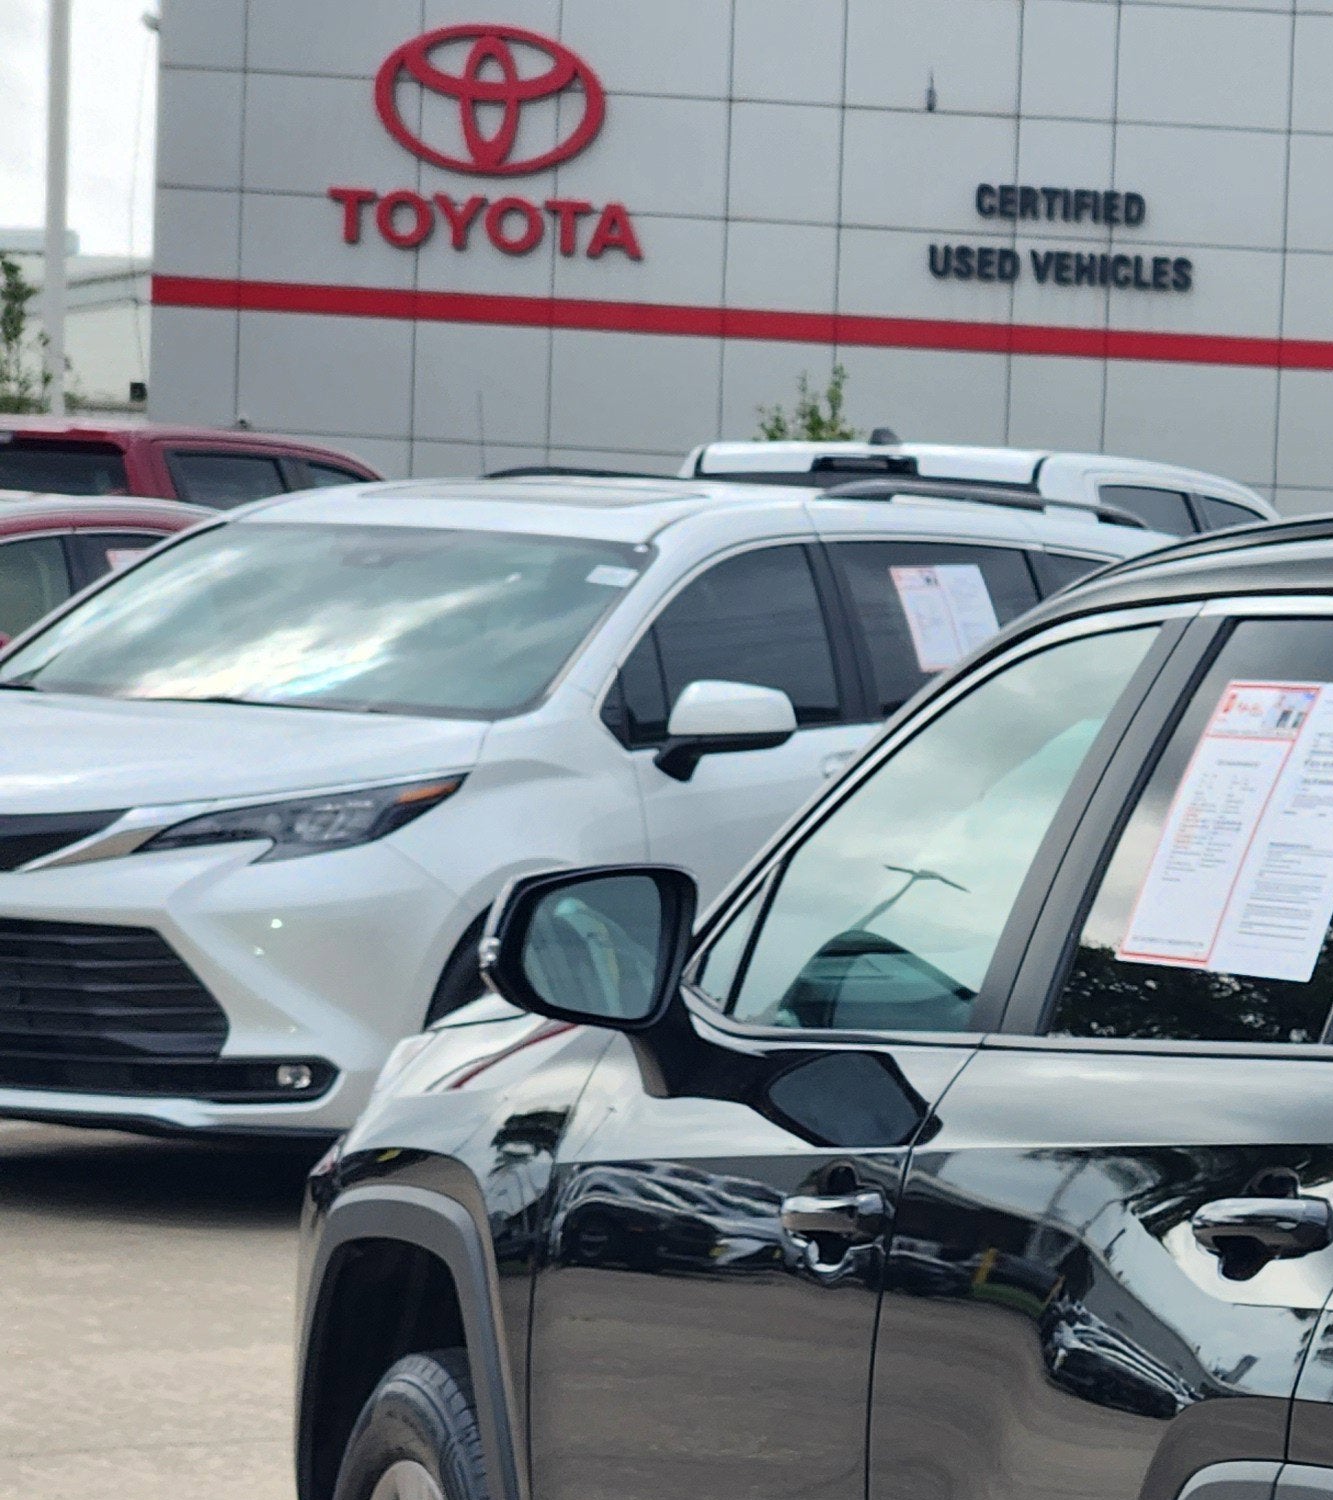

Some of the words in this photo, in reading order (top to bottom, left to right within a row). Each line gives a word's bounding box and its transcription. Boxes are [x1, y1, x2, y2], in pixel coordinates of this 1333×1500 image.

[329, 187, 644, 262] TOYOTA
[975, 183, 1146, 229] CERTIFIED
[929, 244, 1017, 285] USED
[1030, 247, 1194, 294] VEHICLES
